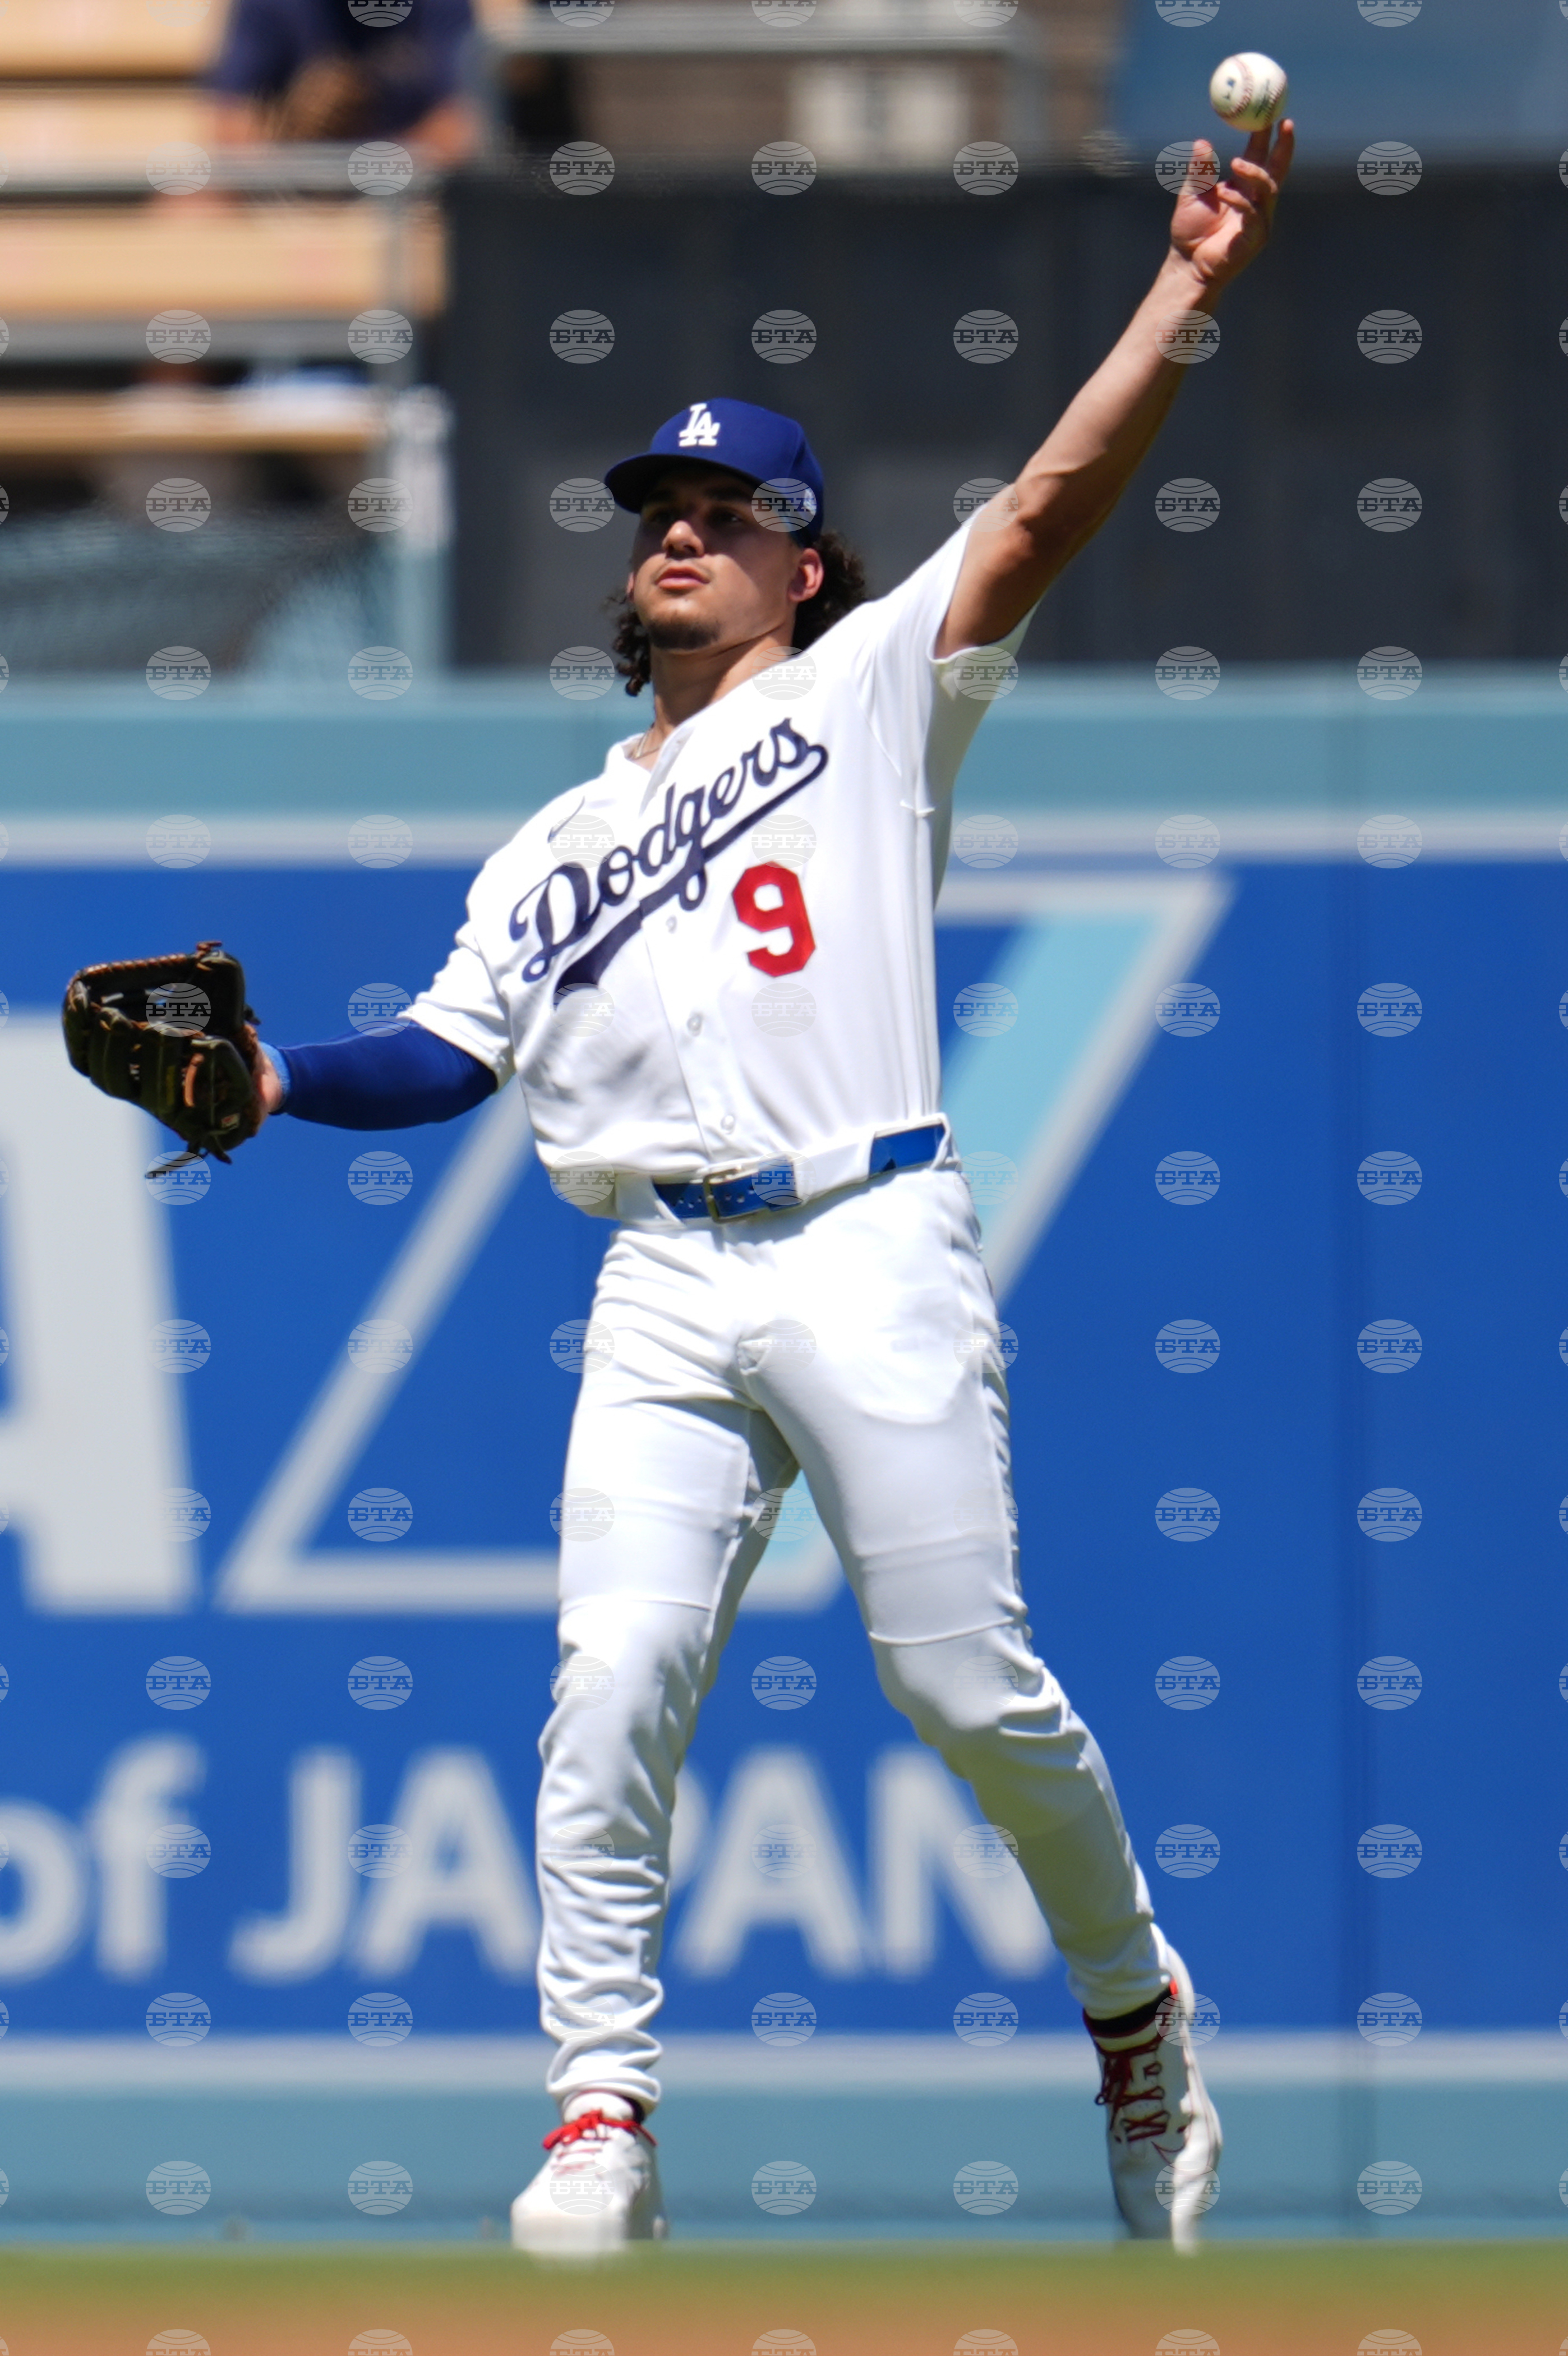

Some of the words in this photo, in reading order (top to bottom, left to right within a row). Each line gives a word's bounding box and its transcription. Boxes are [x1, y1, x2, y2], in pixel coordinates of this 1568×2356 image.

[679, 403, 720, 447] LA
[509, 718, 828, 984] Dodgers
[731, 861, 816, 977] 9
[232, 1745, 1055, 1980] JAAN
